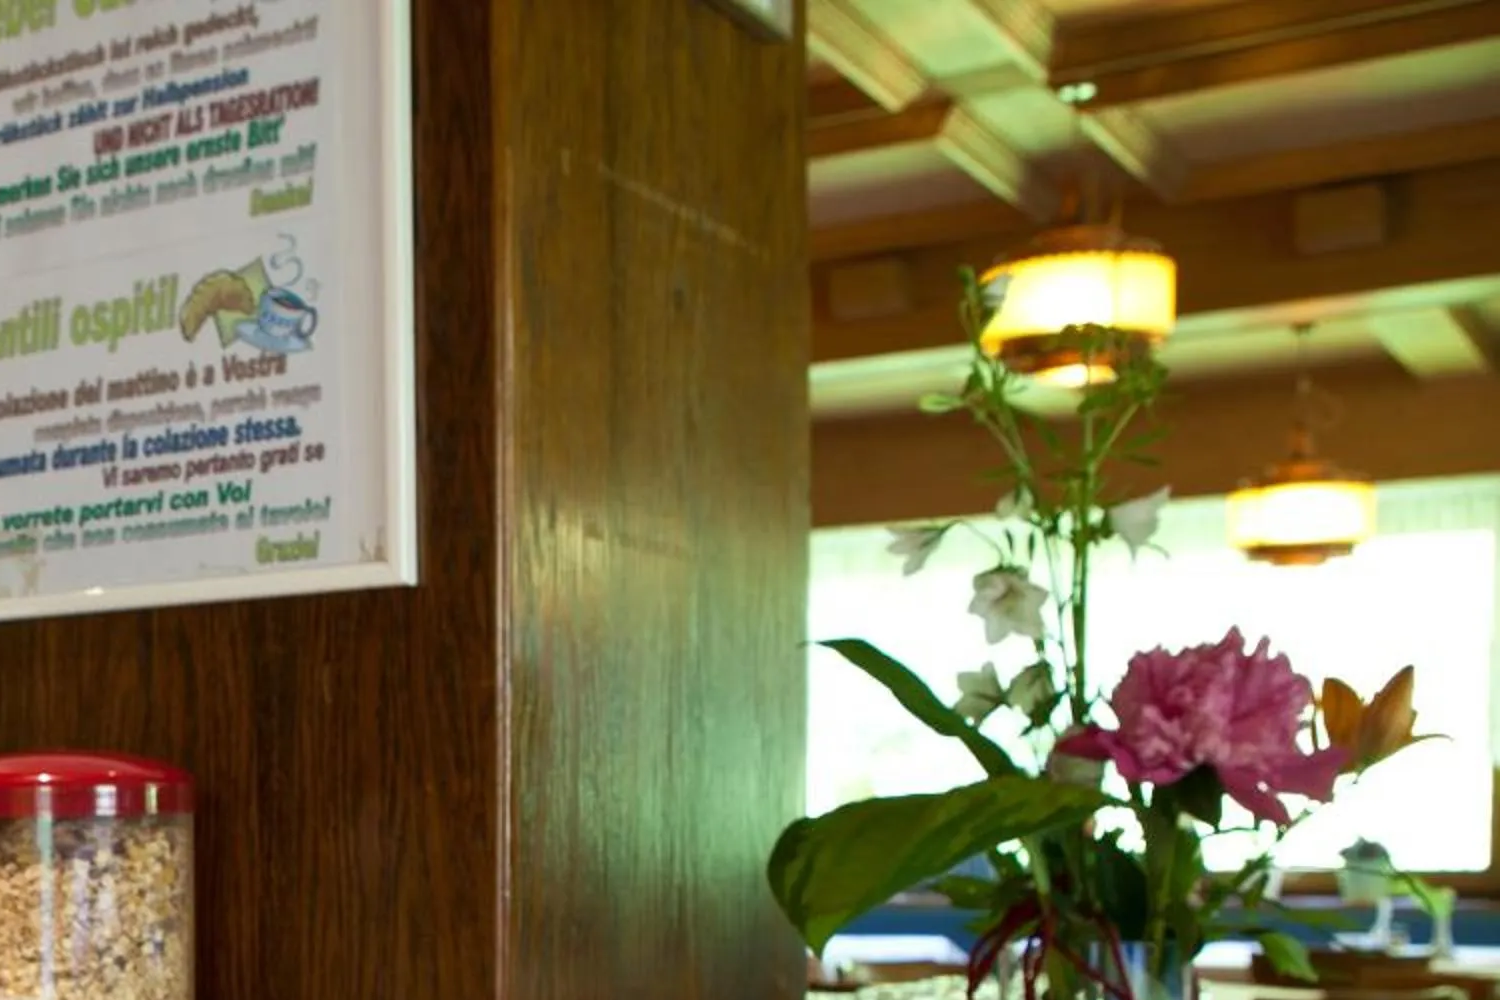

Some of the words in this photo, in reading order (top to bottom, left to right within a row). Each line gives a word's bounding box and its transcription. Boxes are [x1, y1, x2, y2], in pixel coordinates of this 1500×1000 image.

[94, 126, 123, 155] UND
[128, 113, 172, 148] NICHT
[176, 105, 204, 137] ALS
[58, 165, 81, 192] Sie
[86, 153, 120, 185] sich
[125, 146, 181, 176] unsere
[186, 129, 241, 162] ernste
[69, 273, 179, 351] ospiti!
[74, 377, 102, 406] del
[107, 368, 179, 401] mattino
[185, 360, 197, 389] è
[203, 364, 215, 385] a
[222, 352, 287, 383] Vostra
[52, 440, 117, 470] durante
[122, 431, 137, 459] la
[143, 423, 229, 457] colazione
[235, 415, 302, 444] stessa.
[102, 466, 117, 488] Vi
[122, 462, 181, 486] saremo
[185, 450, 256, 479] pertanto
[260, 440, 299, 473] grati
[304, 442, 324, 462] se
[2, 504, 73, 531] vorrete
[79, 490, 164, 527] portarvi
[169, 490, 208, 510] con
[217, 479, 252, 504] Voi
